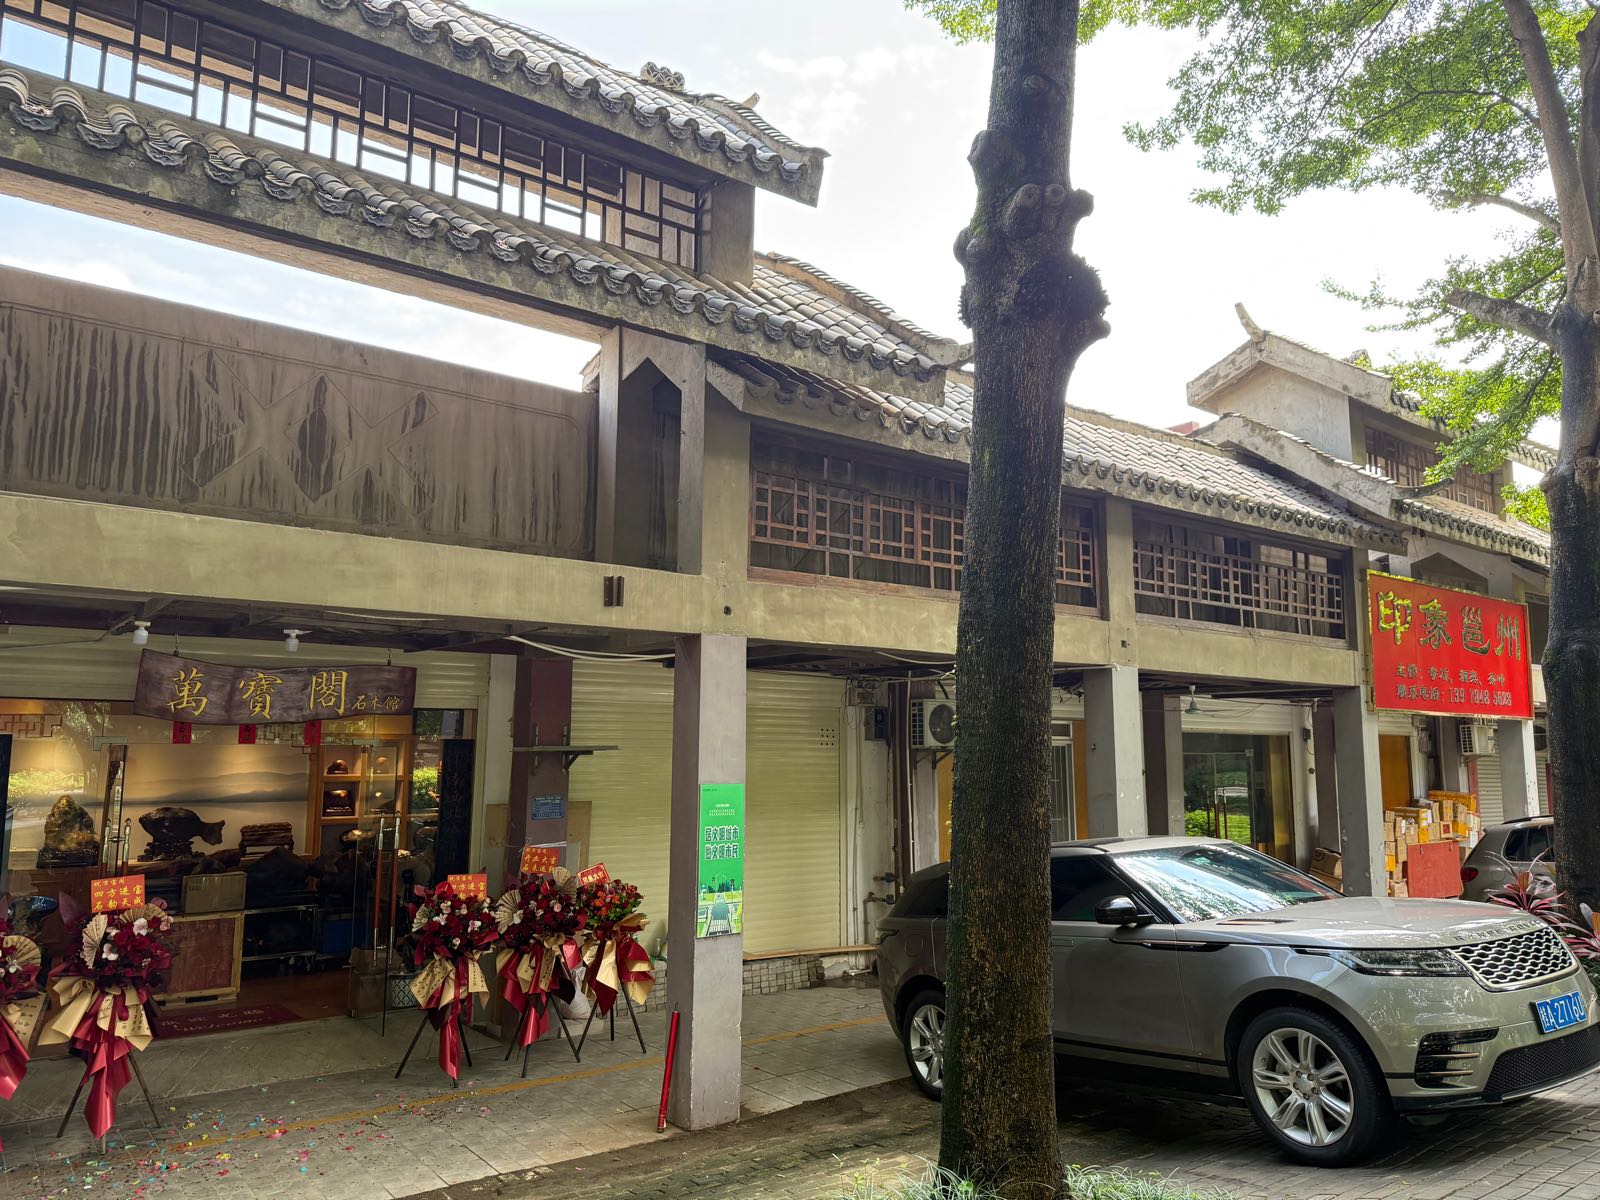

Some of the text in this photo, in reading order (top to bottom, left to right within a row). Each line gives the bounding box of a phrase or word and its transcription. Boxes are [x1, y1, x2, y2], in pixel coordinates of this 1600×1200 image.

[1376, 590, 1521, 661] 印象邕州
[167, 667, 348, 720] 萬寶閣
